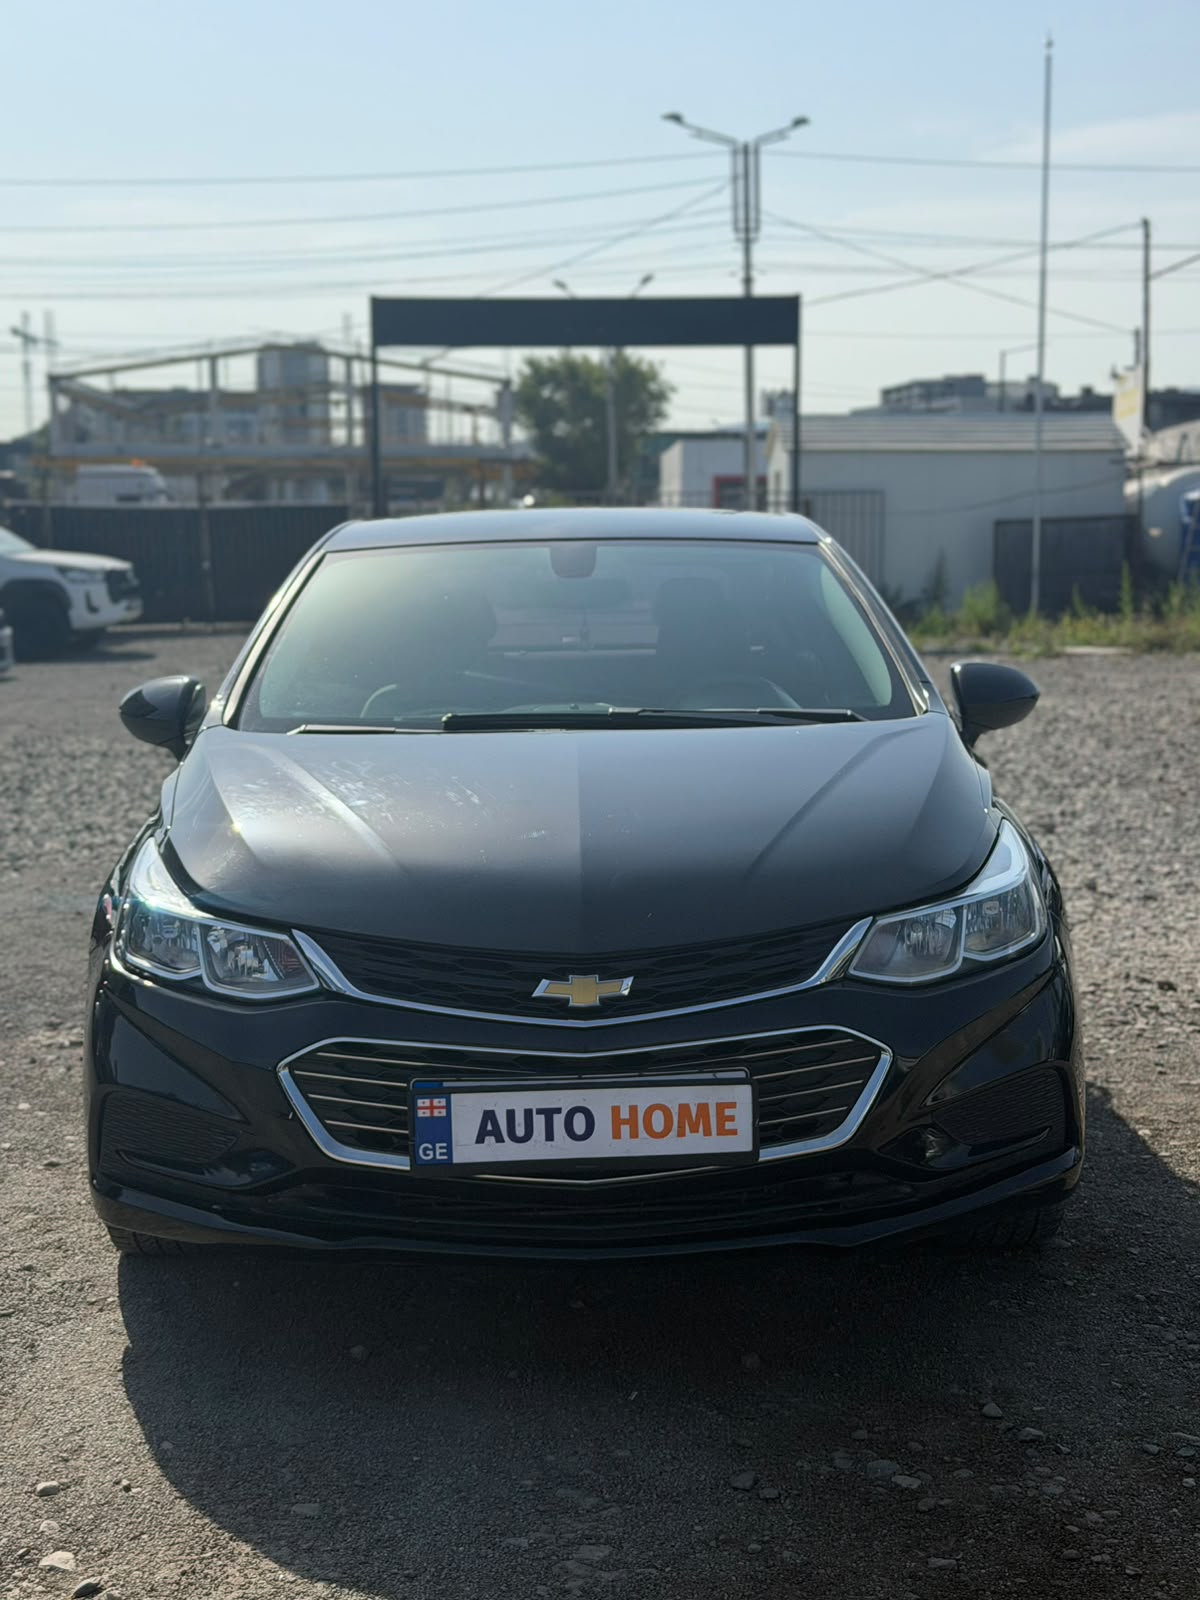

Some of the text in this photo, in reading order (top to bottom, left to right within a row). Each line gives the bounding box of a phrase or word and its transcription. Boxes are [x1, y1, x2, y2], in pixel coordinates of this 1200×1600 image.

[475, 1101, 738, 1145] AUTO HOME
[418, 1143, 448, 1161] GE
